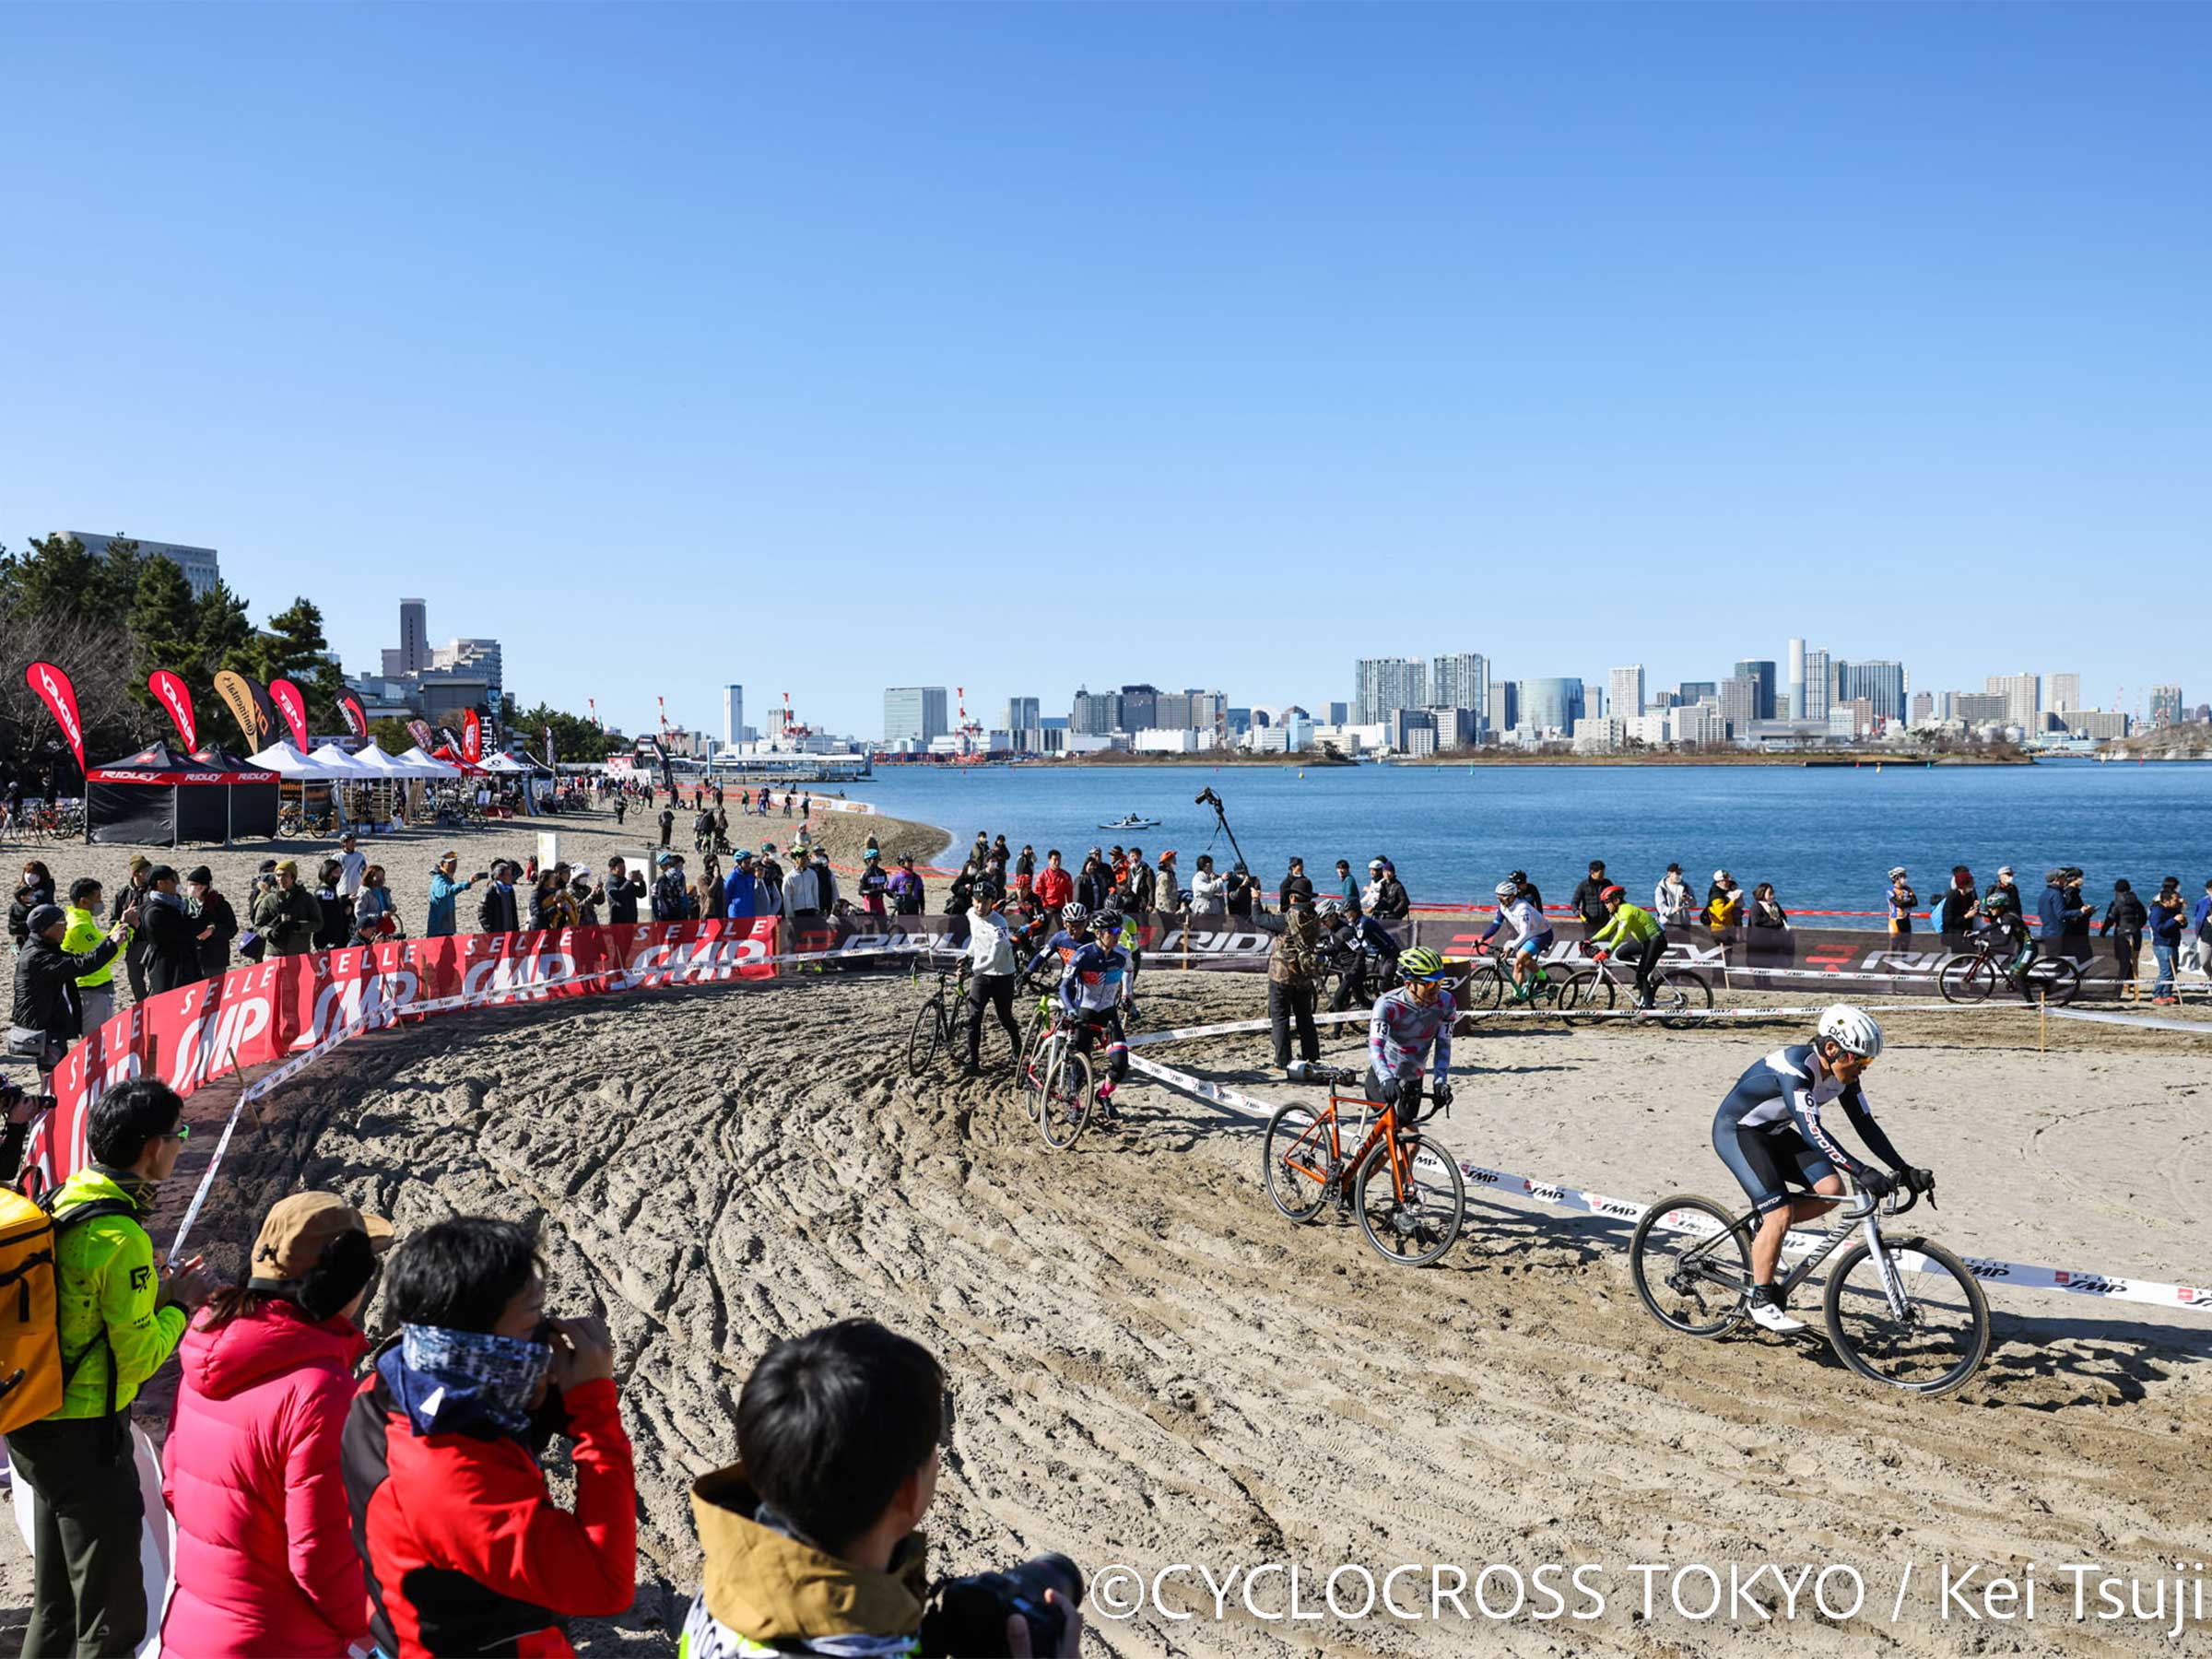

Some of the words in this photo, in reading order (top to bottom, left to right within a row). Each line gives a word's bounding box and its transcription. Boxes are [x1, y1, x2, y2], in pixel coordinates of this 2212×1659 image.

[100, 771, 162, 782] RIDLEY
[185, 773, 215, 782] RIDLEY
[238, 772, 273, 782] RIDLEY
[634, 919, 769, 941] SELLE
[464, 930, 574, 957] SELLE
[315, 943, 418, 978] SELLE
[610, 938, 768, 992] SMP
[462, 952, 577, 1006] SMP
[180, 965, 275, 1016] SELLE
[288, 970, 418, 1048] SMP
[1376, 1021, 1389, 1036] 13
[68, 1008, 143, 1092] SELLE
[168, 995, 271, 1093] SMP
[1804, 1092, 1816, 1108] 6
[1416, 1155, 1439, 1167] MP
[1466, 1170, 1500, 1184] SMP
[1526, 1186, 1565, 1200] SMP
[1599, 1202, 1638, 1217] SMP
[1803, 1221, 1853, 1267] CANYON
[2060, 1279, 2128, 1294] SMP
